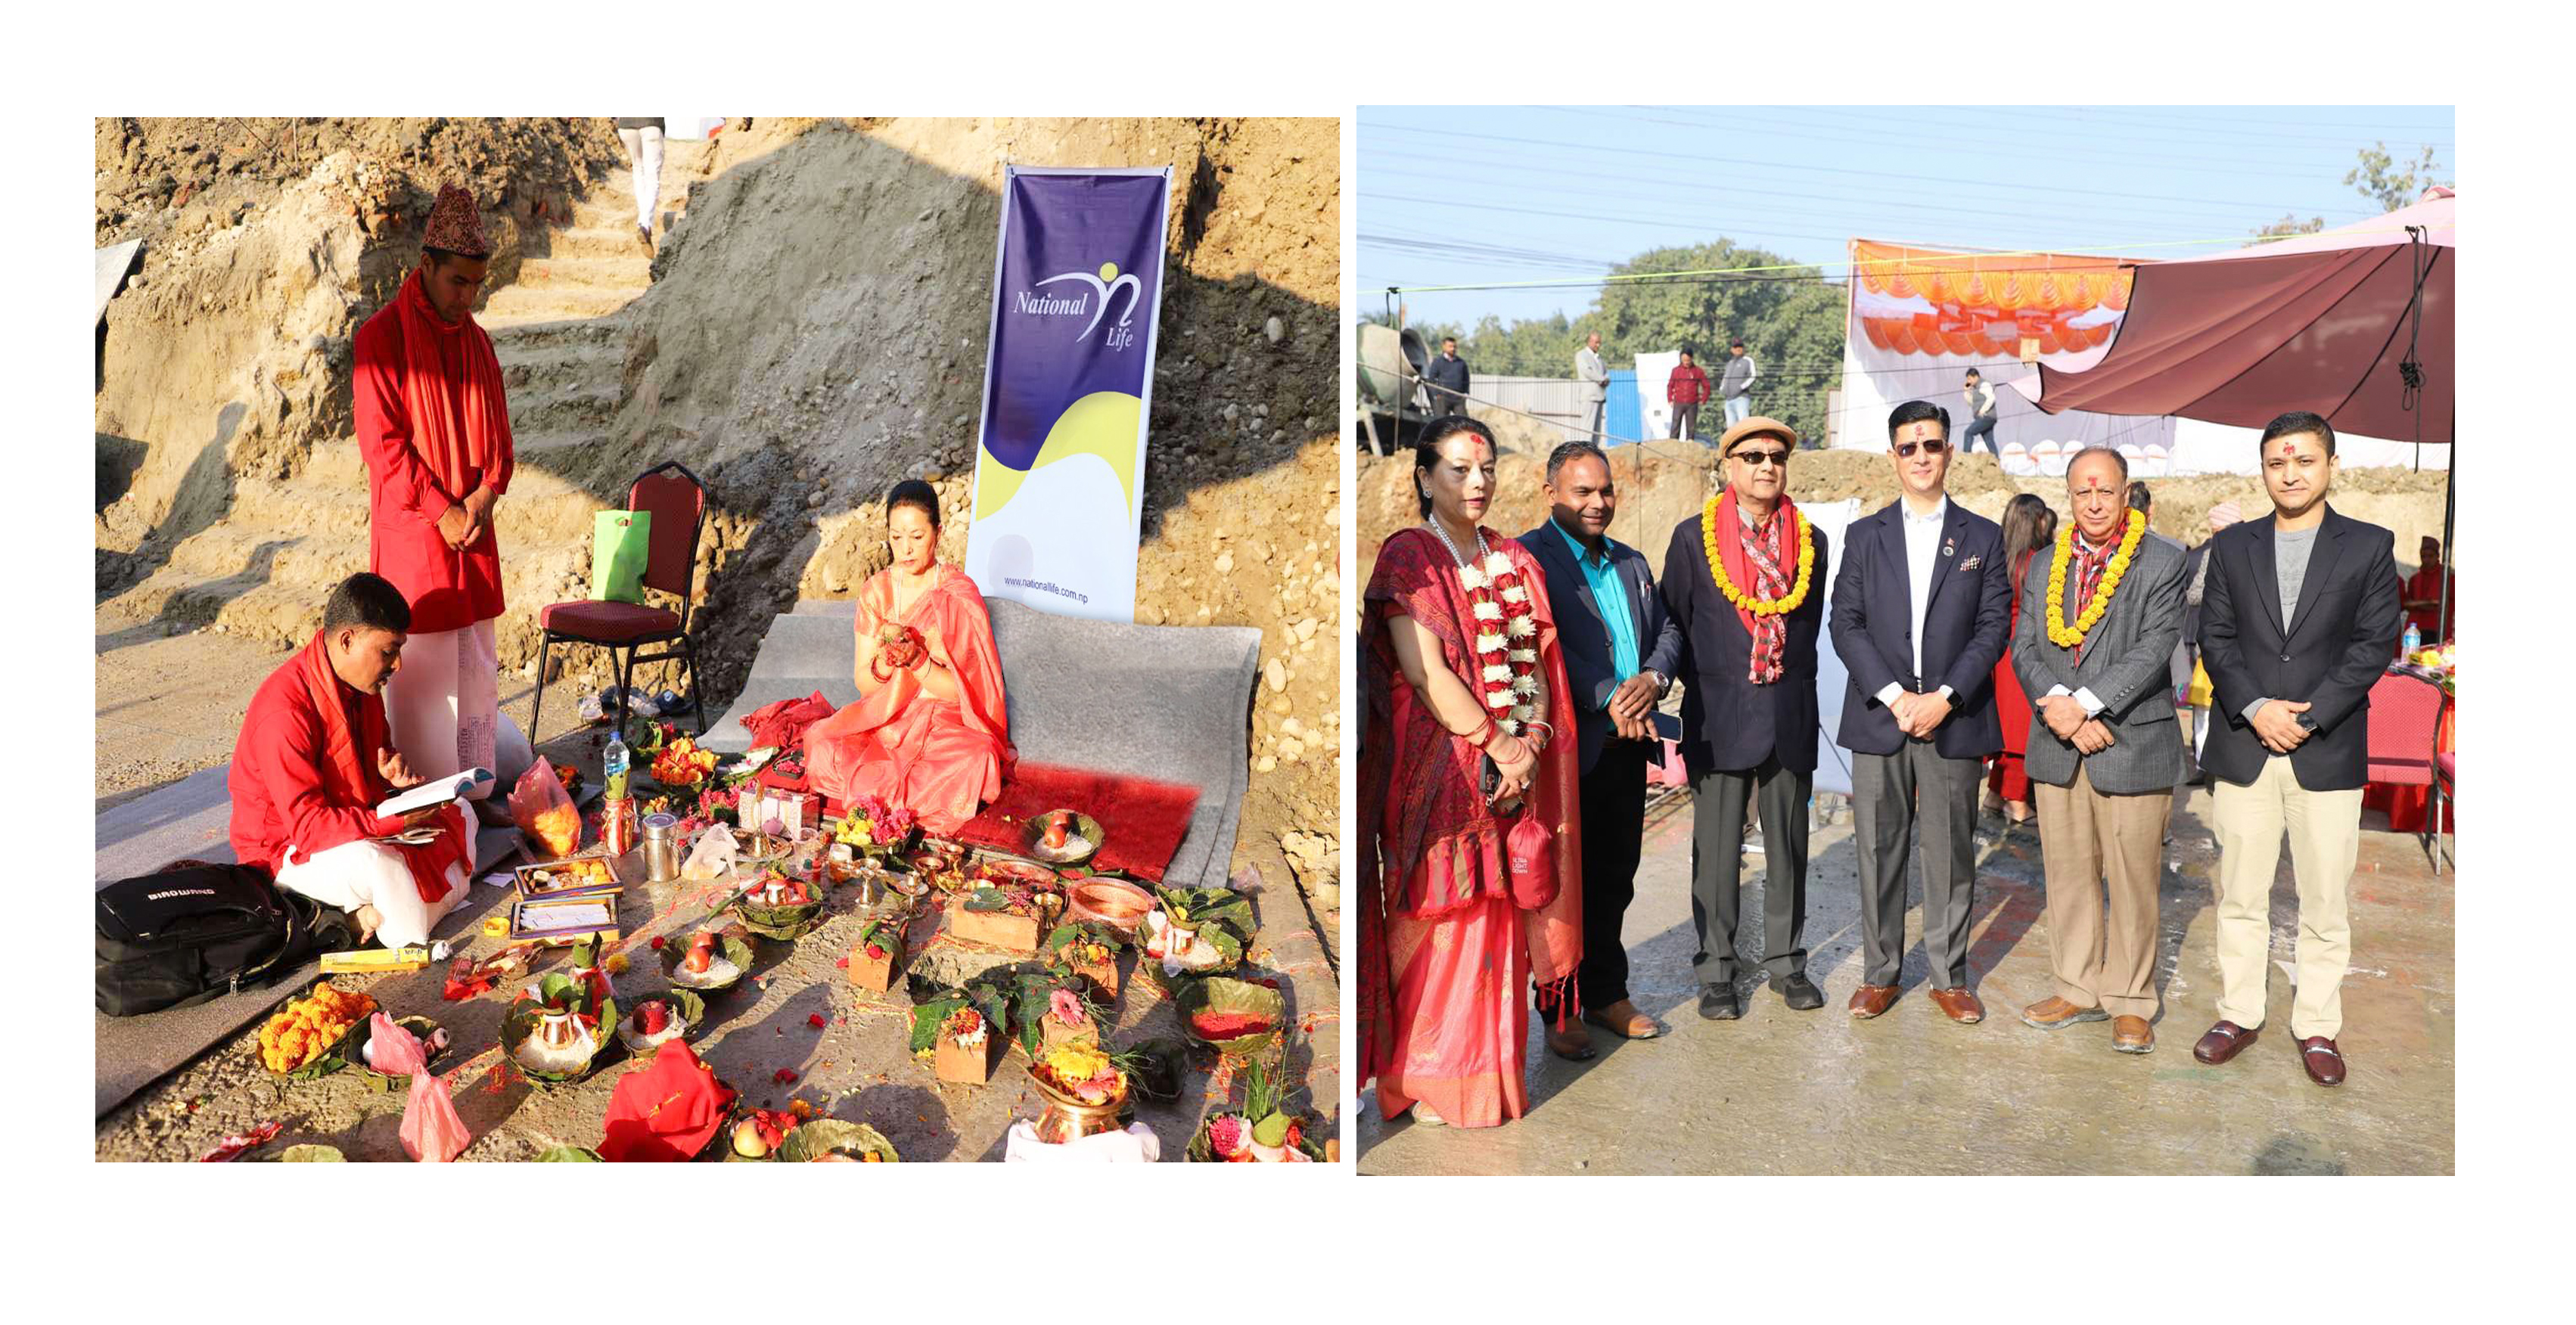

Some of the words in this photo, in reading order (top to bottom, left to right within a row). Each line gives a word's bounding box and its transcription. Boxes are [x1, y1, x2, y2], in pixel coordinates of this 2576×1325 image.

[1014, 291, 1089, 315] National
[1106, 327, 1133, 352] Life
[1004, 576, 1088, 604] www.nationallife.com.np
